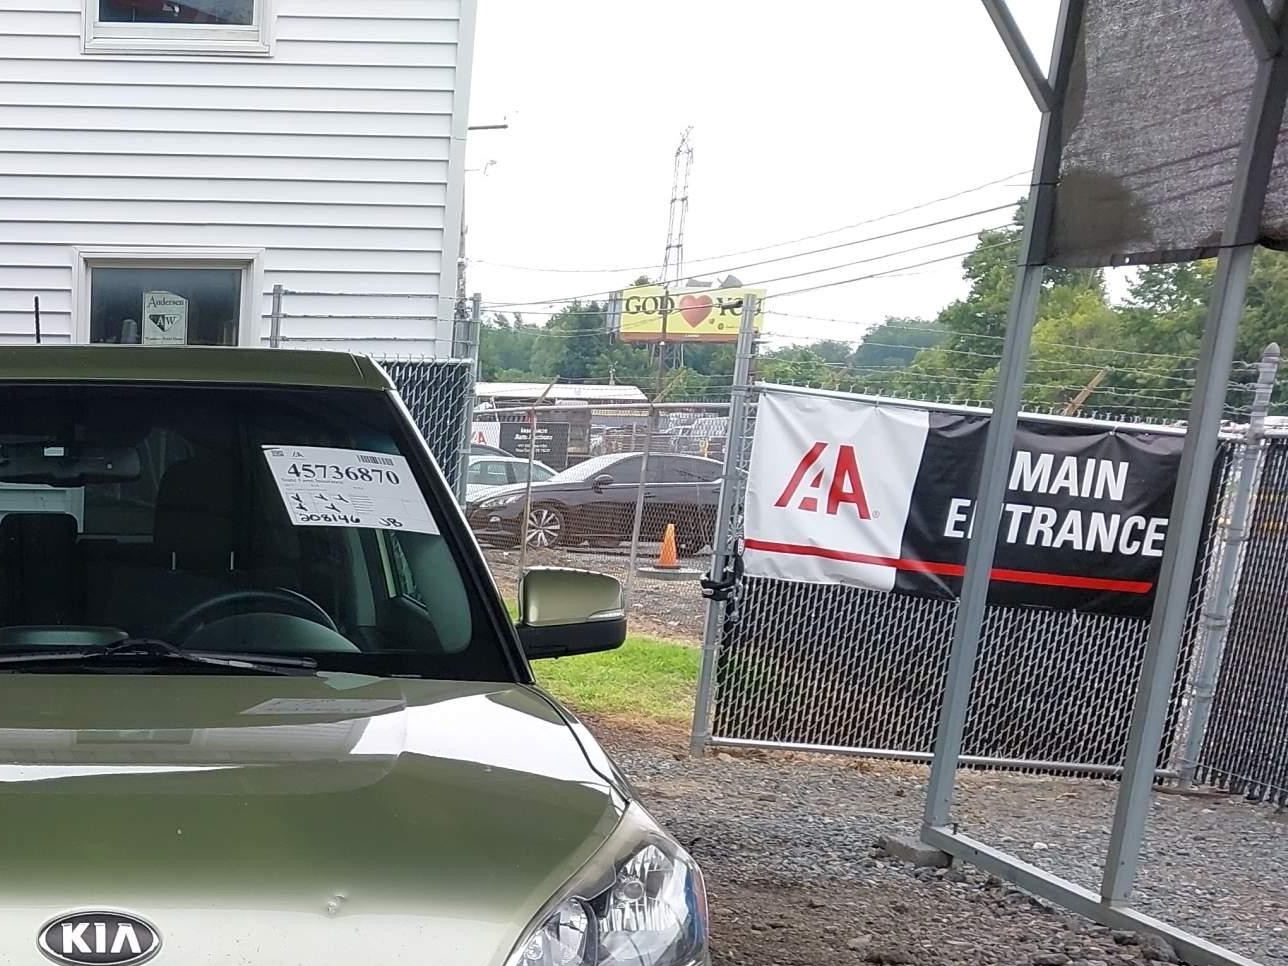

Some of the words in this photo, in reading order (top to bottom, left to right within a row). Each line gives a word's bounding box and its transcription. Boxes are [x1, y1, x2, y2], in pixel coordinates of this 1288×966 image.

[147, 295, 184, 308] Andersen
[625, 296, 675, 316] GOD
[287, 463, 400, 485] 45736870
[1008, 450, 1130, 501] MAIN
[943, 497, 1169, 557] ETRANCE
[61, 922, 142, 954] KIA
